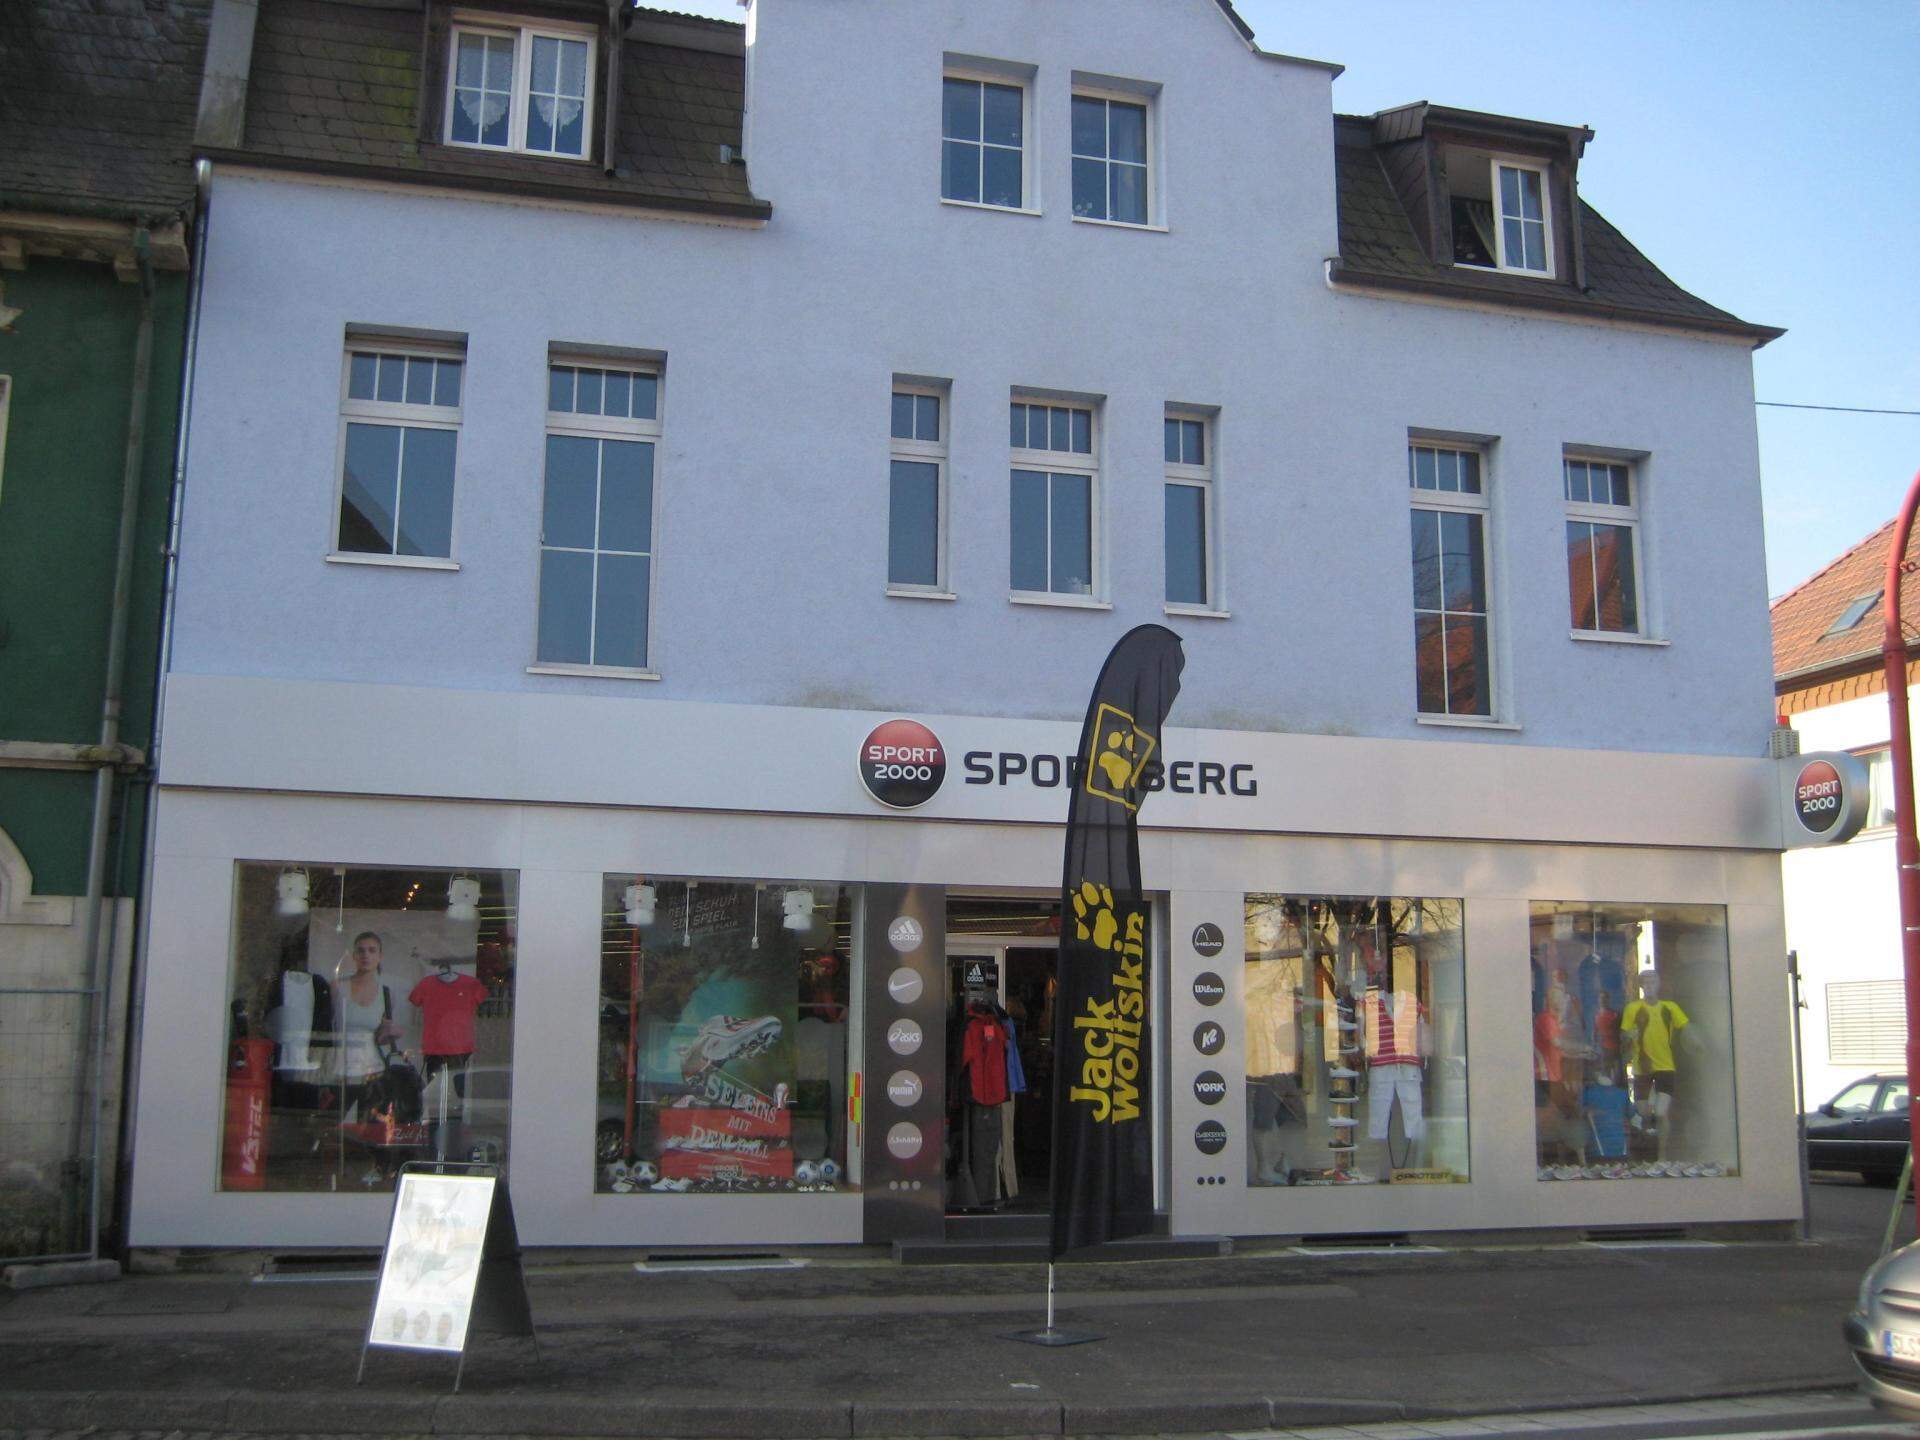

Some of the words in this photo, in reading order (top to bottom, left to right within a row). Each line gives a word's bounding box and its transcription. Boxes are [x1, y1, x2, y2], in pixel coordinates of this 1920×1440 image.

[869, 745, 938, 763] SPORT
[874, 763, 932, 781] 2000
[1798, 780, 1839, 798] SPORT
[1802, 796, 1836, 812] 2000
[1194, 984, 1224, 994] Wilson
[1202, 1028, 1218, 1048] K2
[1070, 997, 1117, 1122] Jack
[1196, 1082, 1225, 1093] YORK
[727, 1114, 752, 1132] MIT
